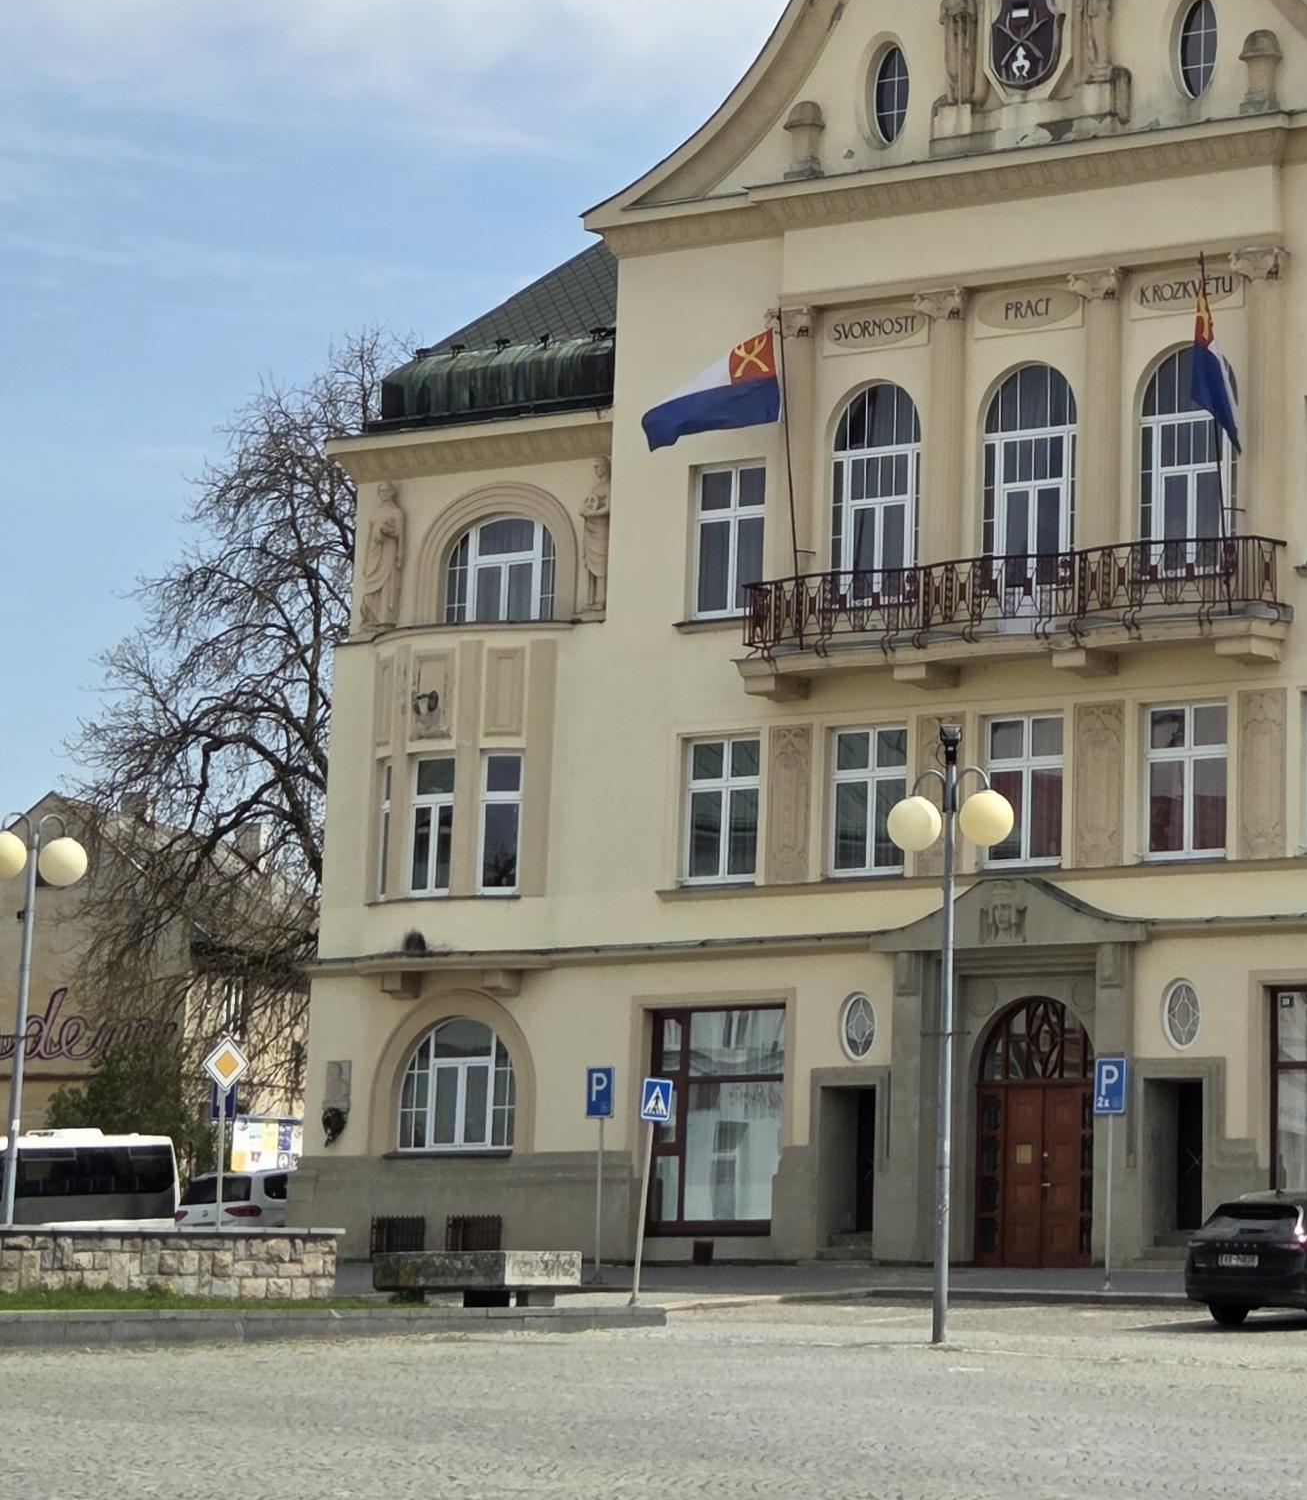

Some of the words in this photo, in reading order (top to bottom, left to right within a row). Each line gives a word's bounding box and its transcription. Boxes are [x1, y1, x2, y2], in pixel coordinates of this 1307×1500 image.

[1140, 285, 1149, 304] K
[591, 1072, 608, 1102] P
[1101, 1065, 1119, 1095] P
